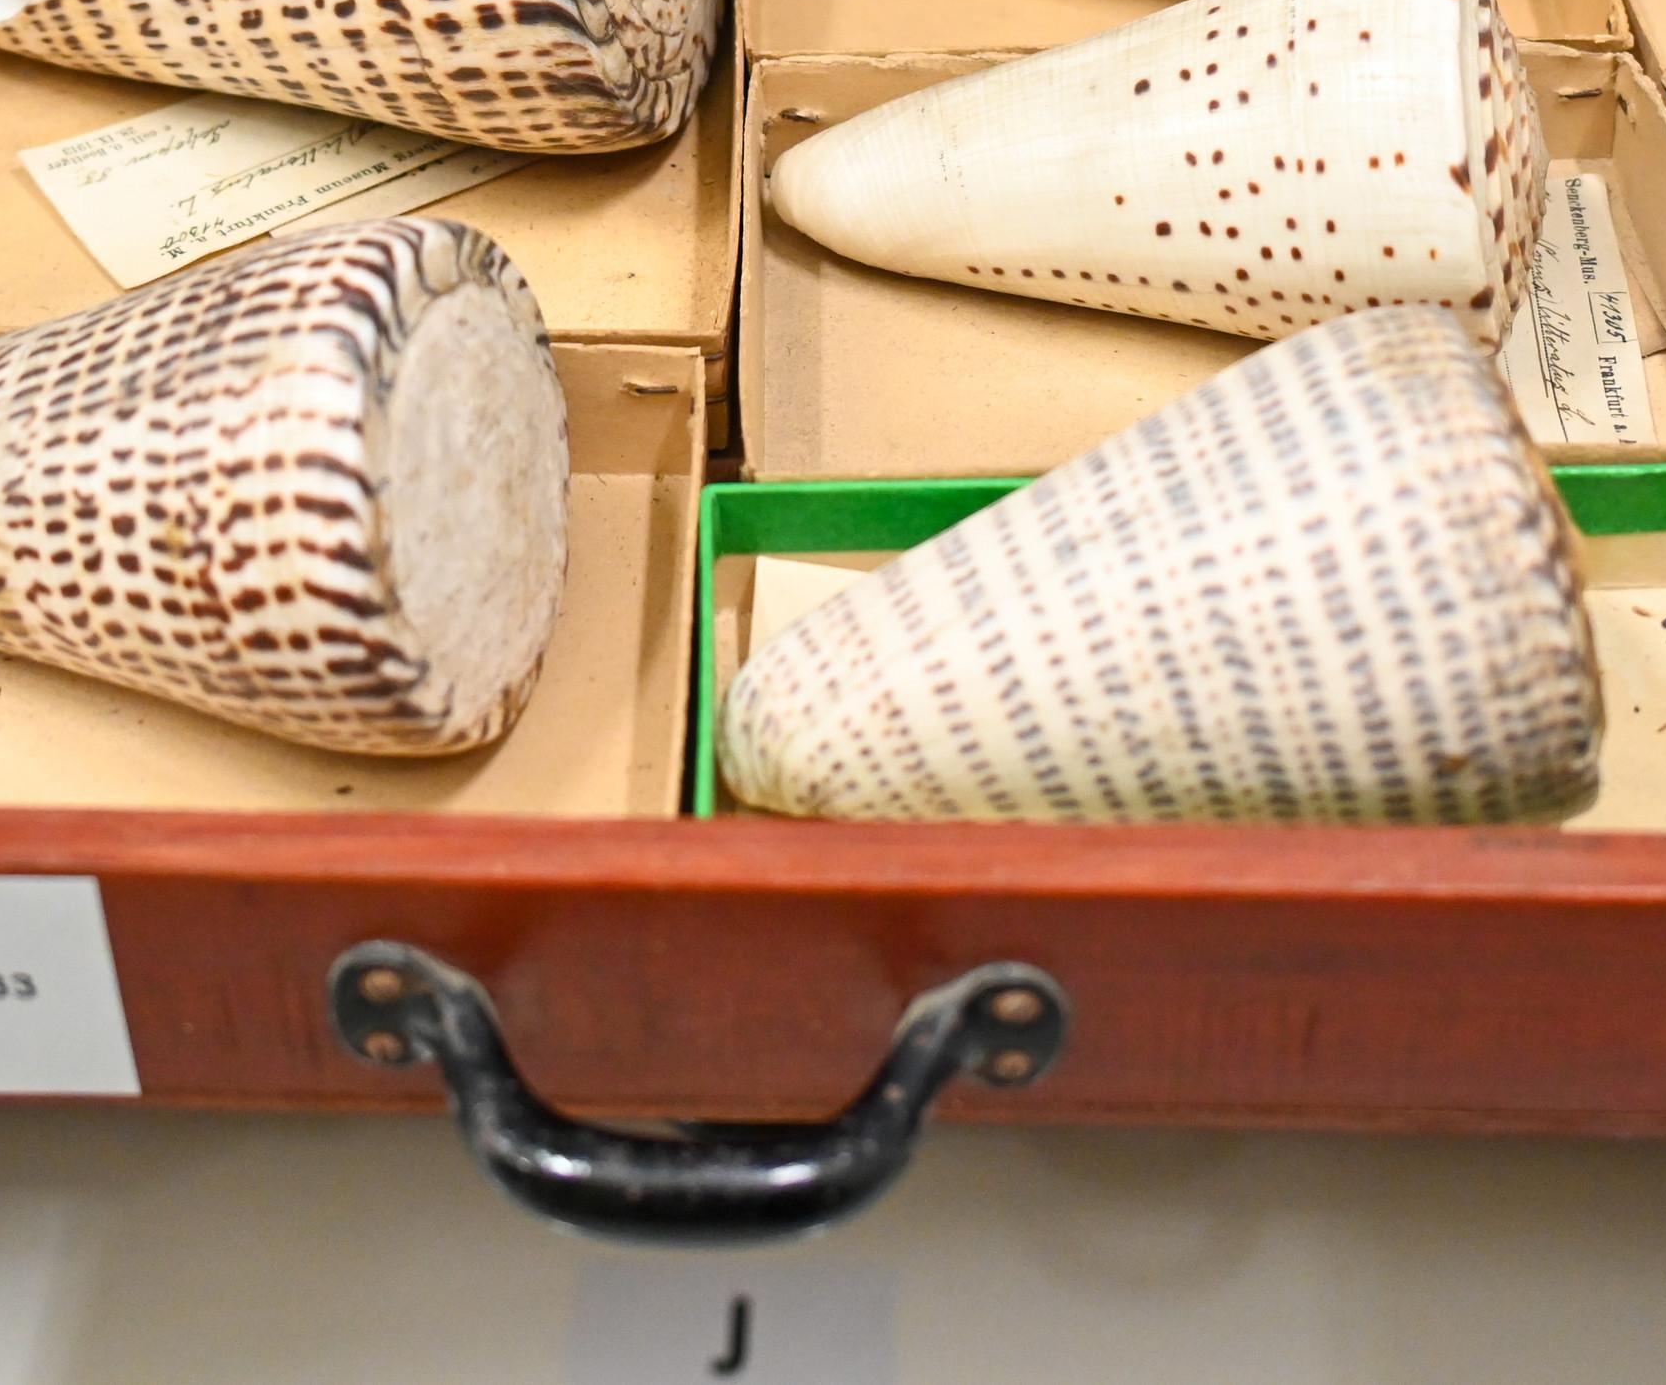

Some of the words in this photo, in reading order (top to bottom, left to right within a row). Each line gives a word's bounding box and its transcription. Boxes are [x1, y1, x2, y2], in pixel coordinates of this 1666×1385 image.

[314, 160, 389, 196] Museum
[217, 194, 310, 239] Frankfurt
[1597, 355, 1629, 419] Frankfurt
[707, 1293, 755, 1377] J
